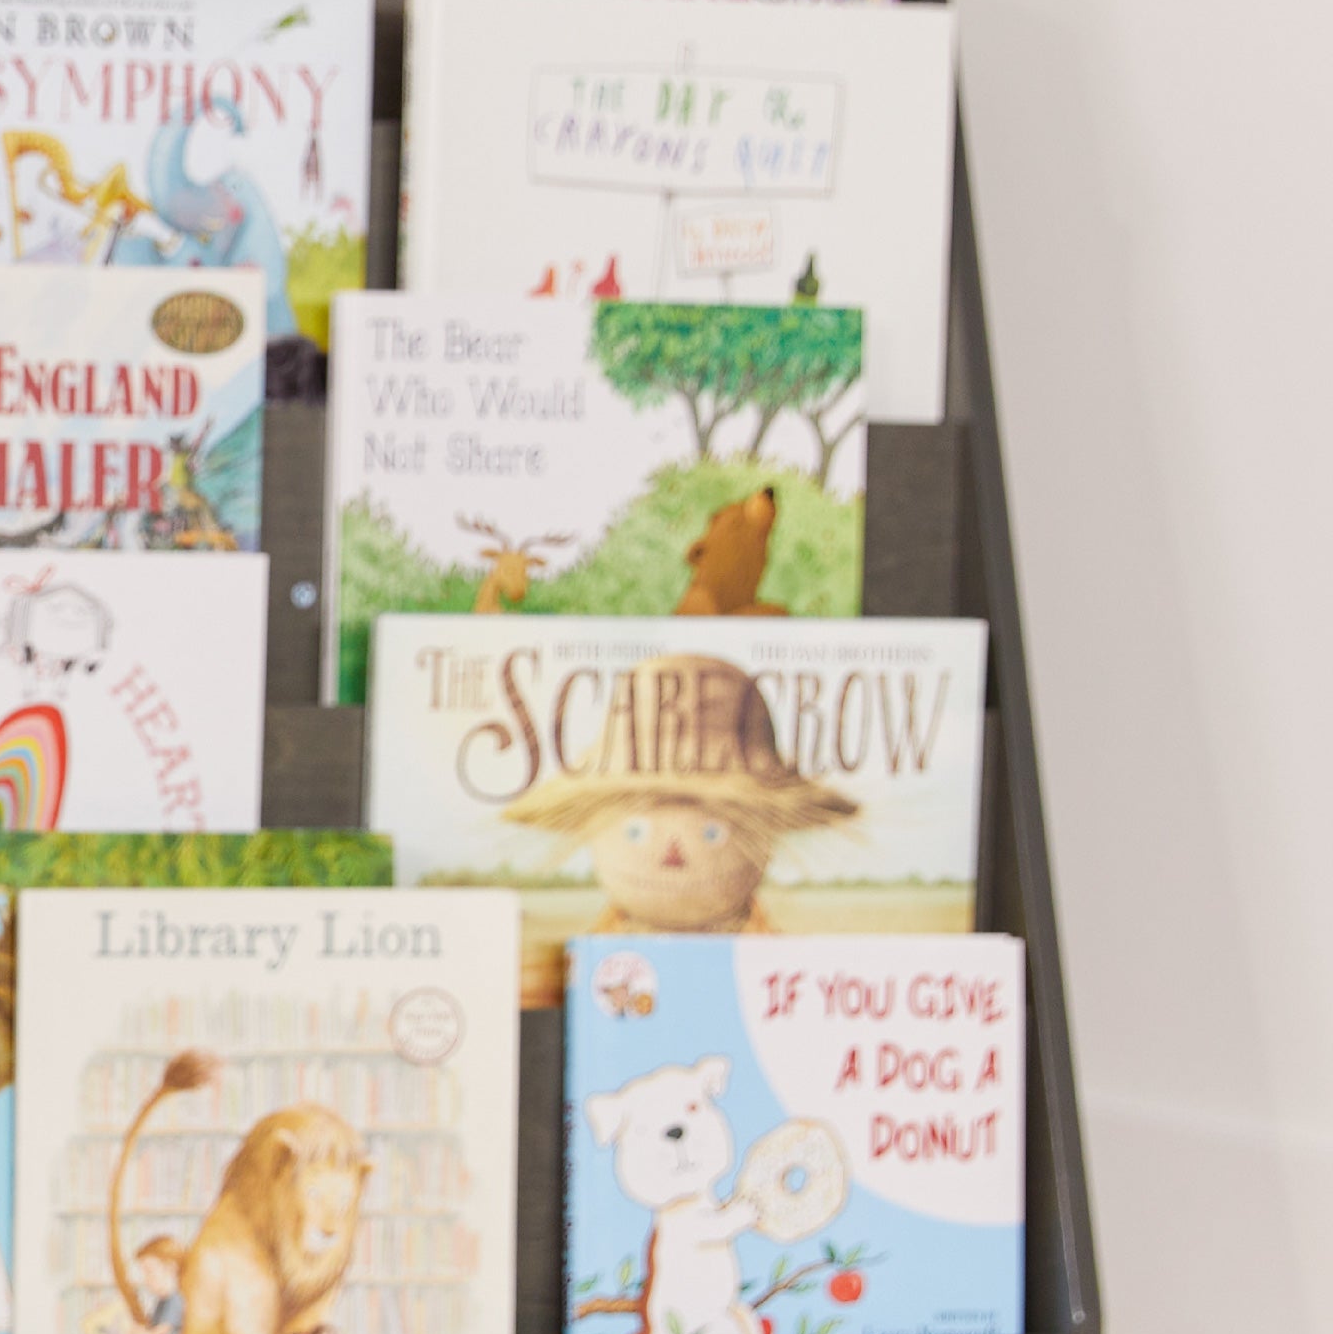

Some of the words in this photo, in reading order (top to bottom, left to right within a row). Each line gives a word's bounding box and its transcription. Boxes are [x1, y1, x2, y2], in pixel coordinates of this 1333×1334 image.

[37, 12, 195, 51] BROWN
[655, 77, 732, 127] DAY
[367, 317, 427, 361] The
[443, 318, 525, 363] Bear
[366, 373, 454, 417] Who
[468, 374, 587, 419] Would
[364, 432, 428, 474] Not
[445, 432, 546, 476] Share
[415, 644, 493, 713] THE
[457, 646, 950, 804] SCARECROW
[93, 910, 299, 971] Library
[318, 910, 443, 960] Lion
[762, 971, 804, 1021] IF
[817, 972, 897, 1020] YOU
[907, 972, 1007, 1025] GIVE
[834, 1043, 860, 1091] A
[875, 1040, 961, 1092] DOG
[975, 1043, 1002, 1091] A
[869, 1110, 1001, 1161] DONUT
